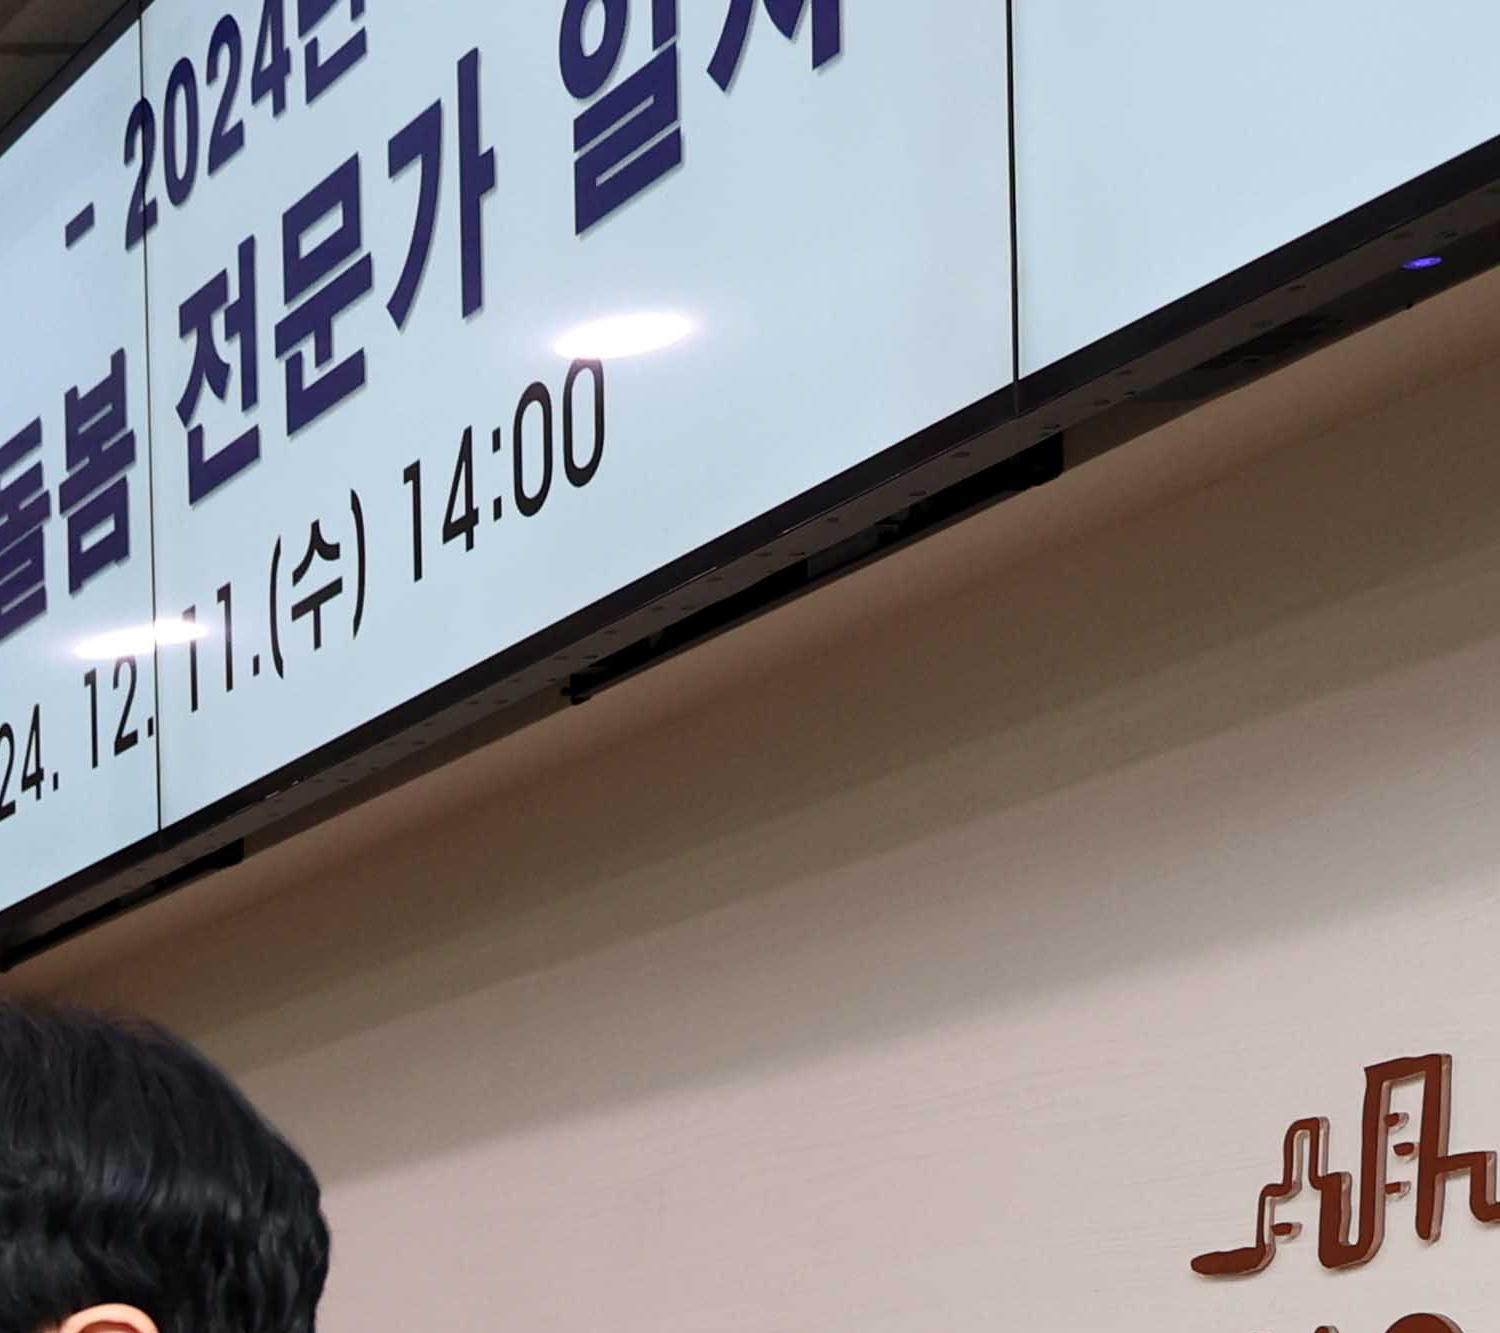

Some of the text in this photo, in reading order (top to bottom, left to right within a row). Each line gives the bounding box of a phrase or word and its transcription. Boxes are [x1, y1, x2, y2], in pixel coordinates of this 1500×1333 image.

[175, 46, 496, 507] 전문가
[84, 655, 154, 770] 12.
[403, 355, 605, 583] 14:00
